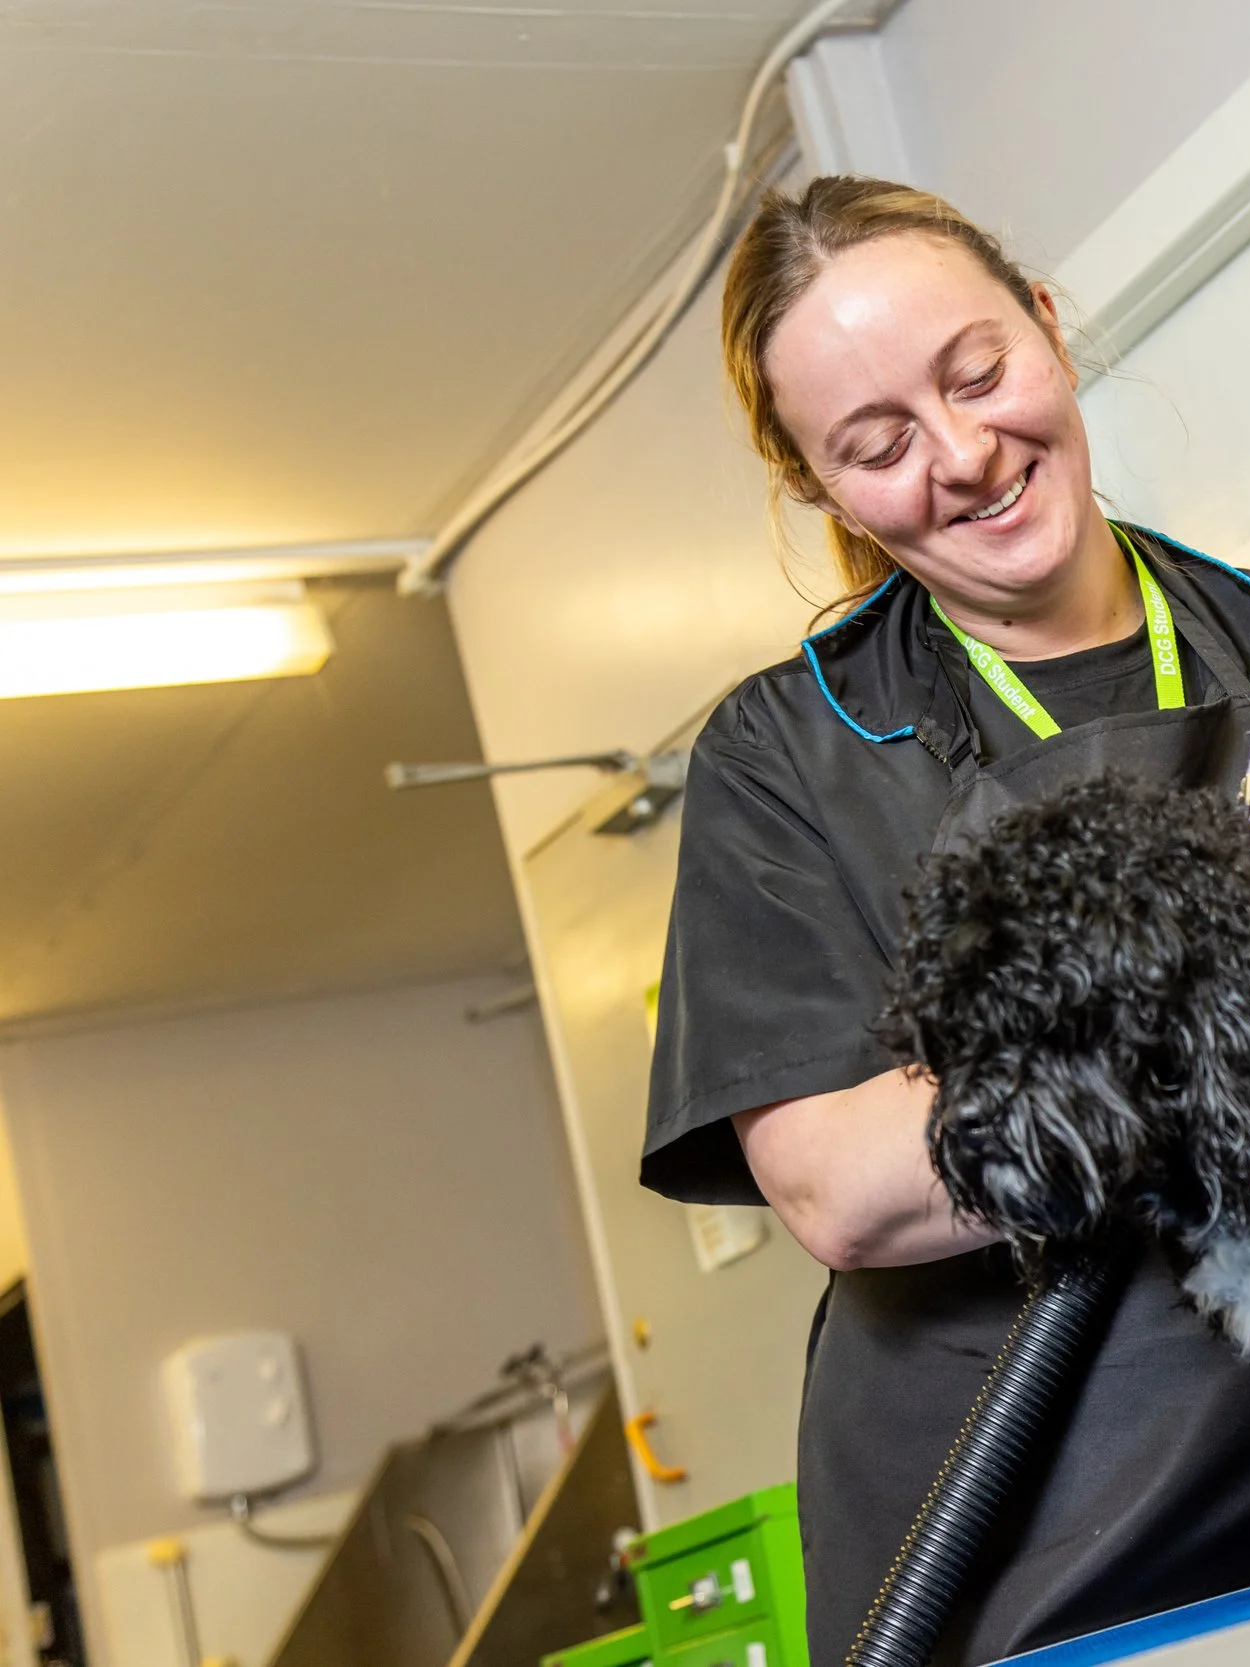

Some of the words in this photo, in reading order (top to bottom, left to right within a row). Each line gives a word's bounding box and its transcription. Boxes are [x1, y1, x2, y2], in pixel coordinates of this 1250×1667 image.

[1148, 582, 1170, 635] Student
[964, 635, 991, 669] DCG
[987, 664, 1036, 720] Student
[1156, 639, 1176, 675] DCG
